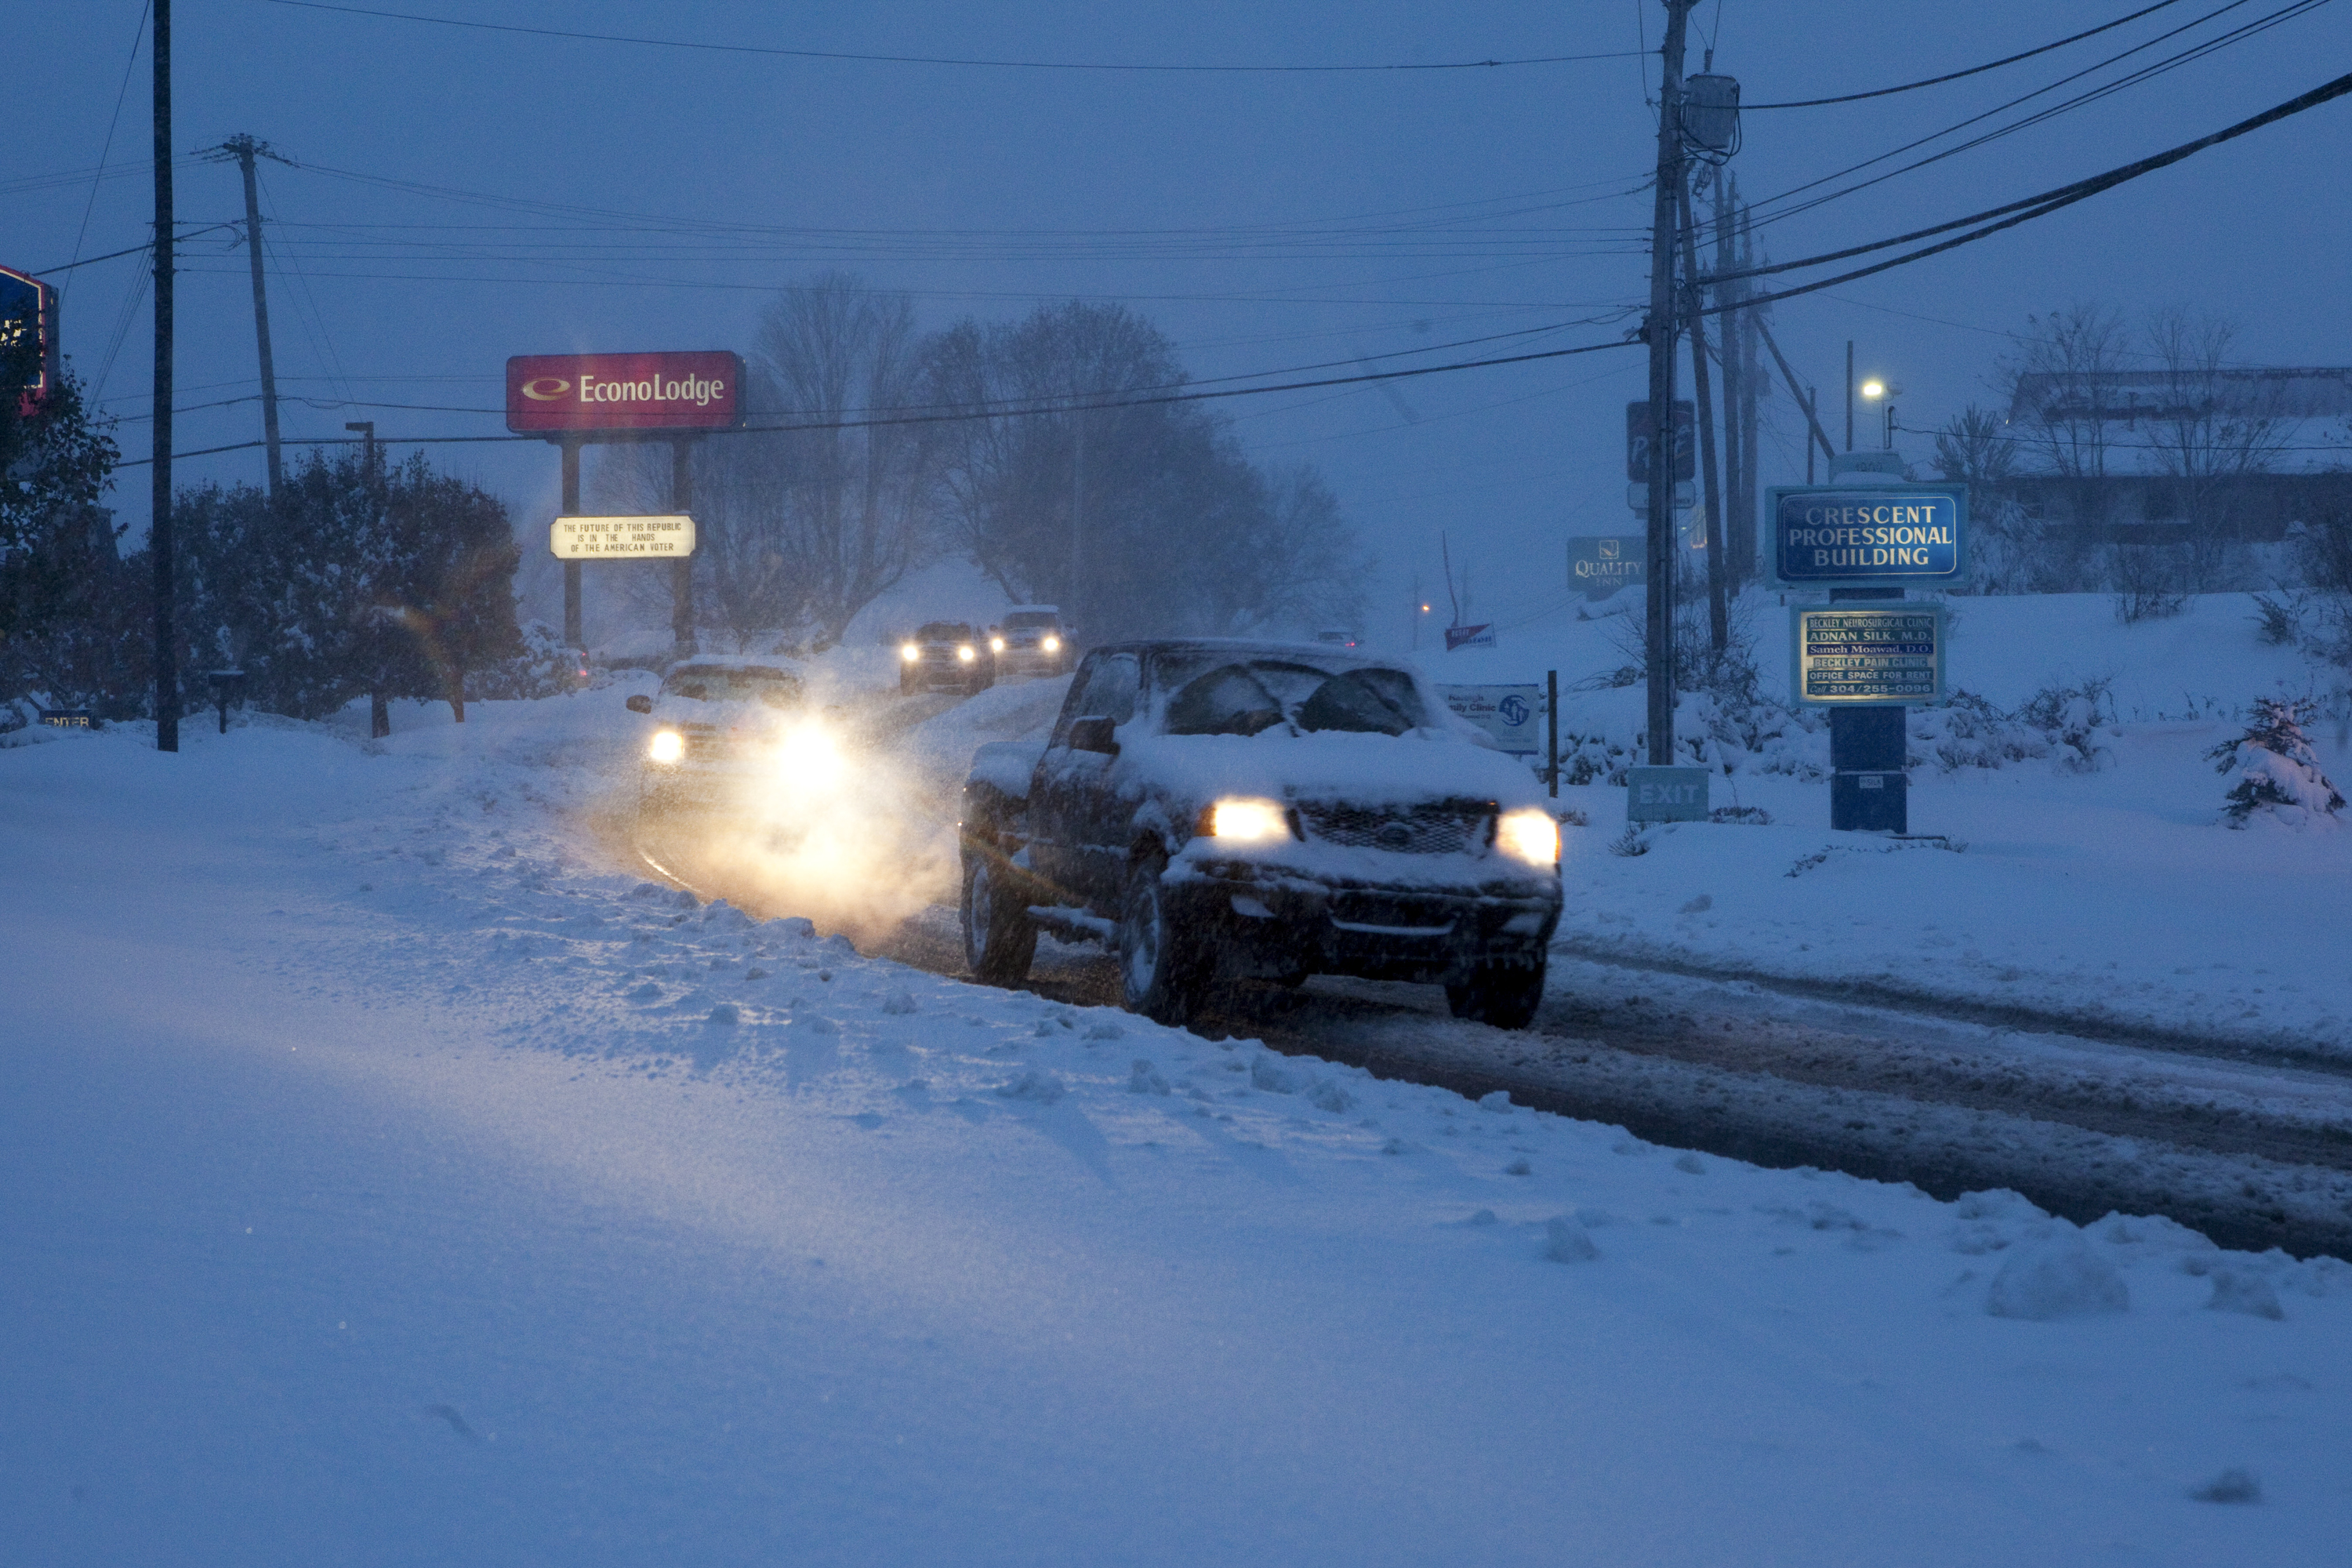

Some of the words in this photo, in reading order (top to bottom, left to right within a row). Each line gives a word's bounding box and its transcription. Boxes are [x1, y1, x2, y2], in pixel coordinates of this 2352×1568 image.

[580, 373, 724, 406] EconoLodge
[1806, 506, 1936, 525] CRESCENT
[580, 524, 609, 532] FUTURE
[627, 523, 644, 532] THIS
[647, 523, 681, 532] REPUBLIC
[632, 533, 655, 542] HANDS
[1789, 526, 1953, 546] PROFESSIONAL
[604, 543, 645, 552] AMERICAN
[650, 543, 674, 551] VOTER
[1814, 547, 1929, 566] BUILDING
[1809, 619, 1840, 628] BECKLEY
[1843, 618, 1904, 628] NEUROSURGICAL
[1907, 617, 1932, 627] CLINIC
[1809, 632, 1857, 641] ADNAN
[1901, 631, 1932, 641] M.D.
[1810, 645, 1848, 654] Sameh
[1851, 644, 1903, 655] Moawad,
[1906, 644, 1932, 653] D.O.
[1814, 658, 1860, 667] BECKLEY
[1864, 658, 1889, 667] PAIN
[1892, 657, 1927, 666] CLINIC
[1848, 671, 1878, 680] SPACE
[1883, 671, 1902, 680] FOR
[1830, 684, 1930, 693] 304/255-0096
[1469, 703, 1496, 712] Clinic
[1639, 784, 1700, 804] EXIT
